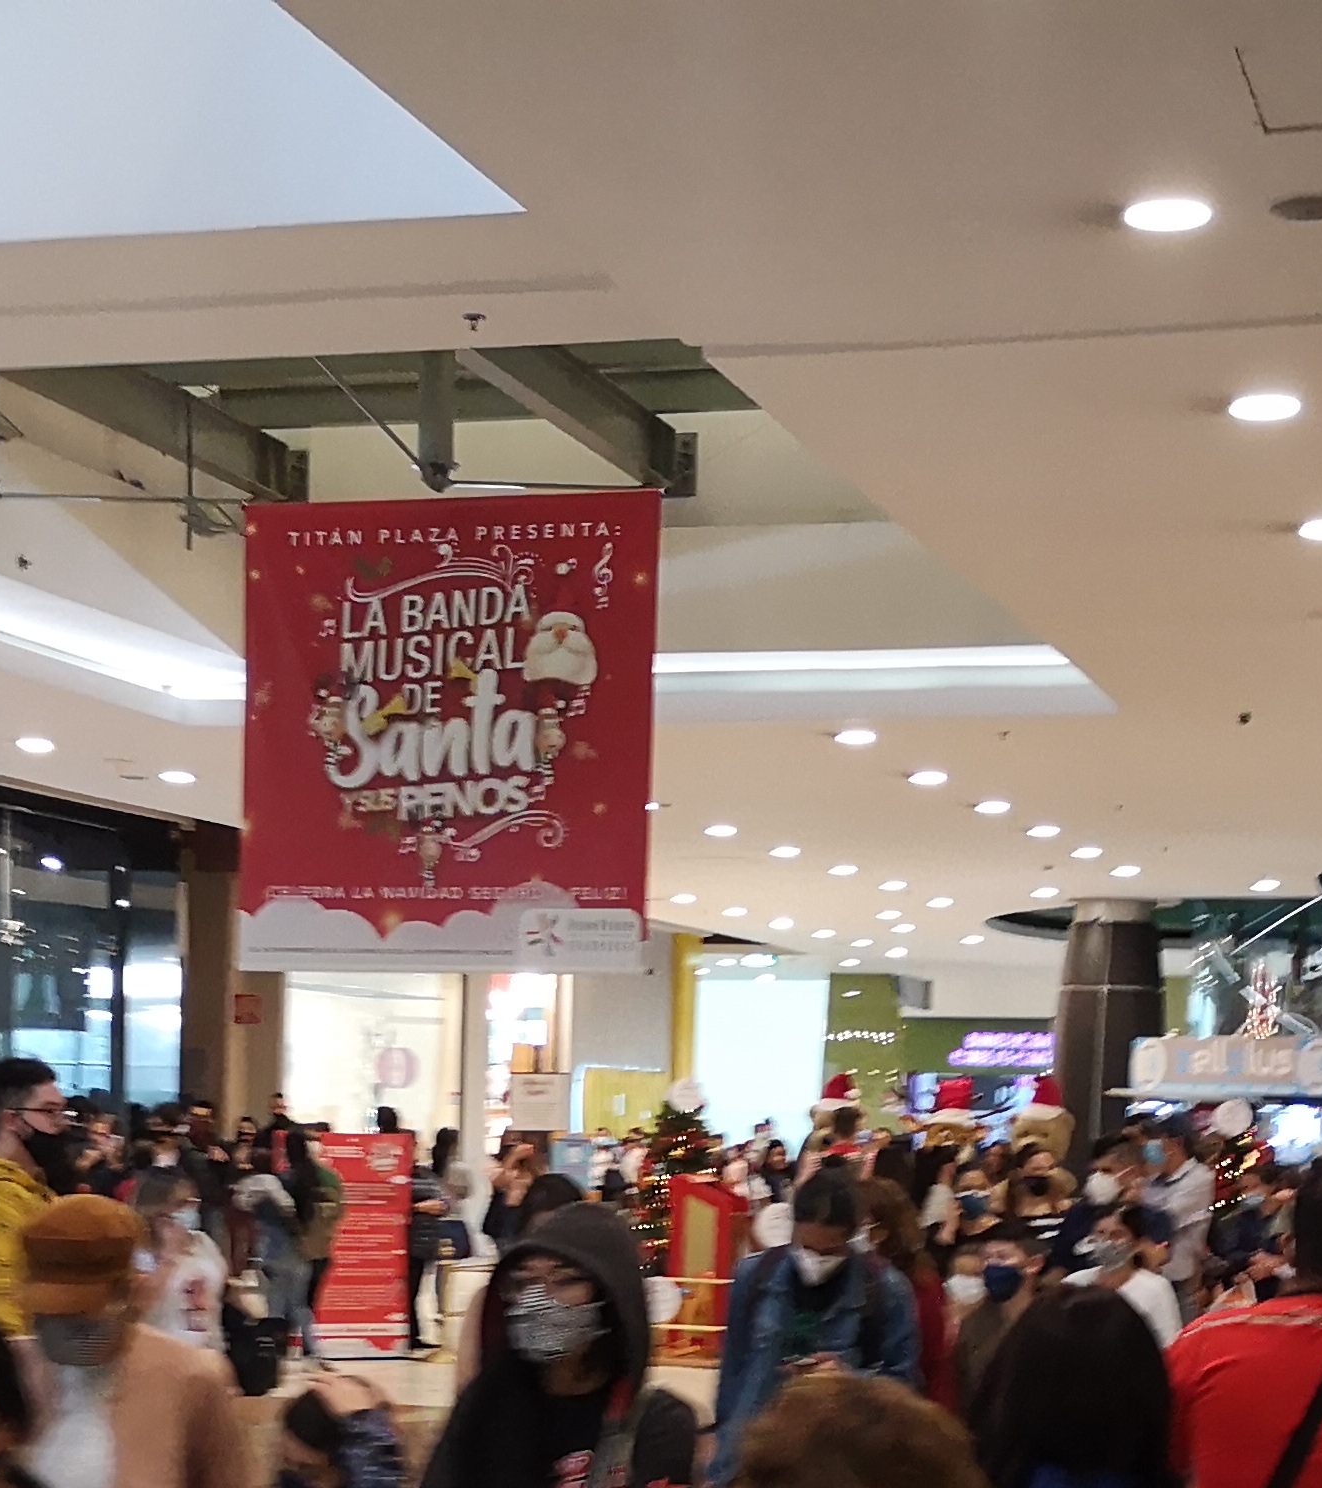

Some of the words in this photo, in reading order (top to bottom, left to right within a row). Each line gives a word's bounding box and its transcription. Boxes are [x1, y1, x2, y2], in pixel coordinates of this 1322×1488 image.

[287, 528, 363, 547] TITÁN
[377, 527, 459, 545] PLAZA
[474, 522, 622, 541] PRESENTA:
[341, 598, 388, 639] LA
[400, 583, 531, 634] BANDA
[340, 627, 525, 683] MUSICAL
[403, 680, 444, 715] DE
[326, 668, 538, 789] Santa
[396, 775, 532, 822] RENOS
